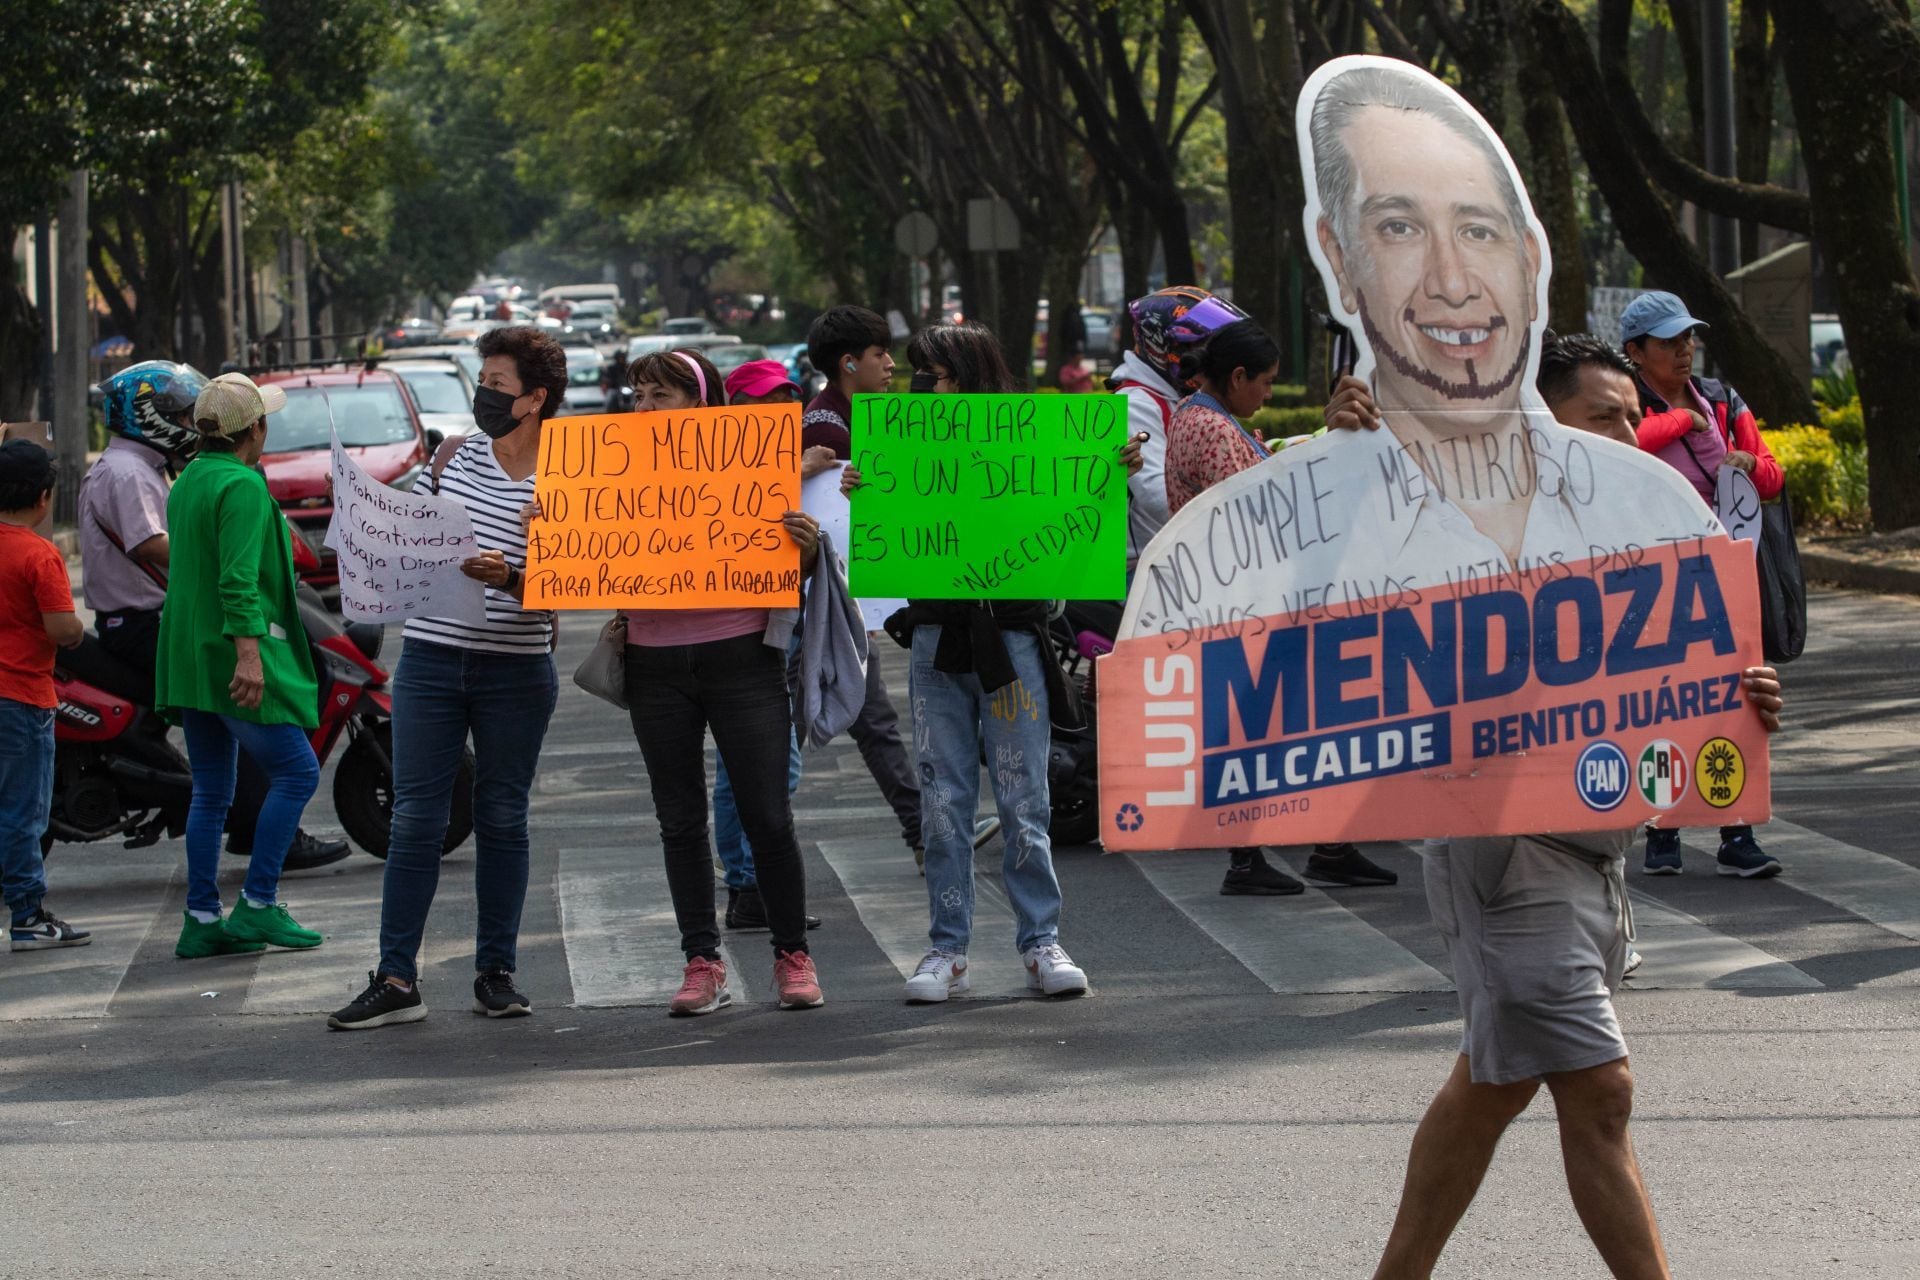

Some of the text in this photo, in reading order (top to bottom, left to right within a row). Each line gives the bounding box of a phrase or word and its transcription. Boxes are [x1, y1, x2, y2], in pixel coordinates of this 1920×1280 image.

[860, 397, 1116, 443] TRABAJAR NO
[544, 413, 796, 478] LUIS MENDOZA
[855, 451, 897, 494] ES
[913, 456, 959, 496] UN
[350, 502, 474, 547] Creatividad
[532, 488, 568, 523] NO
[578, 482, 722, 522] TENEMOS
[732, 481, 790, 524] LOS
[1150, 428, 1595, 617] NO CUMPLE MENTIROSO
[339, 529, 460, 574] rabajo Digno
[529, 519, 781, 564] $20,000 QUE PIDES
[852, 524, 888, 562] ES
[902, 520, 960, 559] UNA
[363, 577, 384, 593] de
[395, 577, 431, 592] los
[527, 569, 591, 599] PARA
[705, 574, 717, 593] A
[716, 558, 800, 594] TRABAJAR
[1282, 575, 1423, 626] VECINOS
[1446, 551, 1574, 601] VOTAMOS
[1587, 543, 1650, 582] POR
[1143, 553, 1737, 807] LUIS MENDOZA
[1472, 672, 1743, 759] BENITO JUÁREZ
[1217, 723, 1434, 800] ALCALDE
[1585, 759, 1620, 793] PAN
[1641, 750, 1682, 789] PRI
[1217, 797, 1310, 826] CANDIDATO
[1710, 786, 1731, 801] PRD
